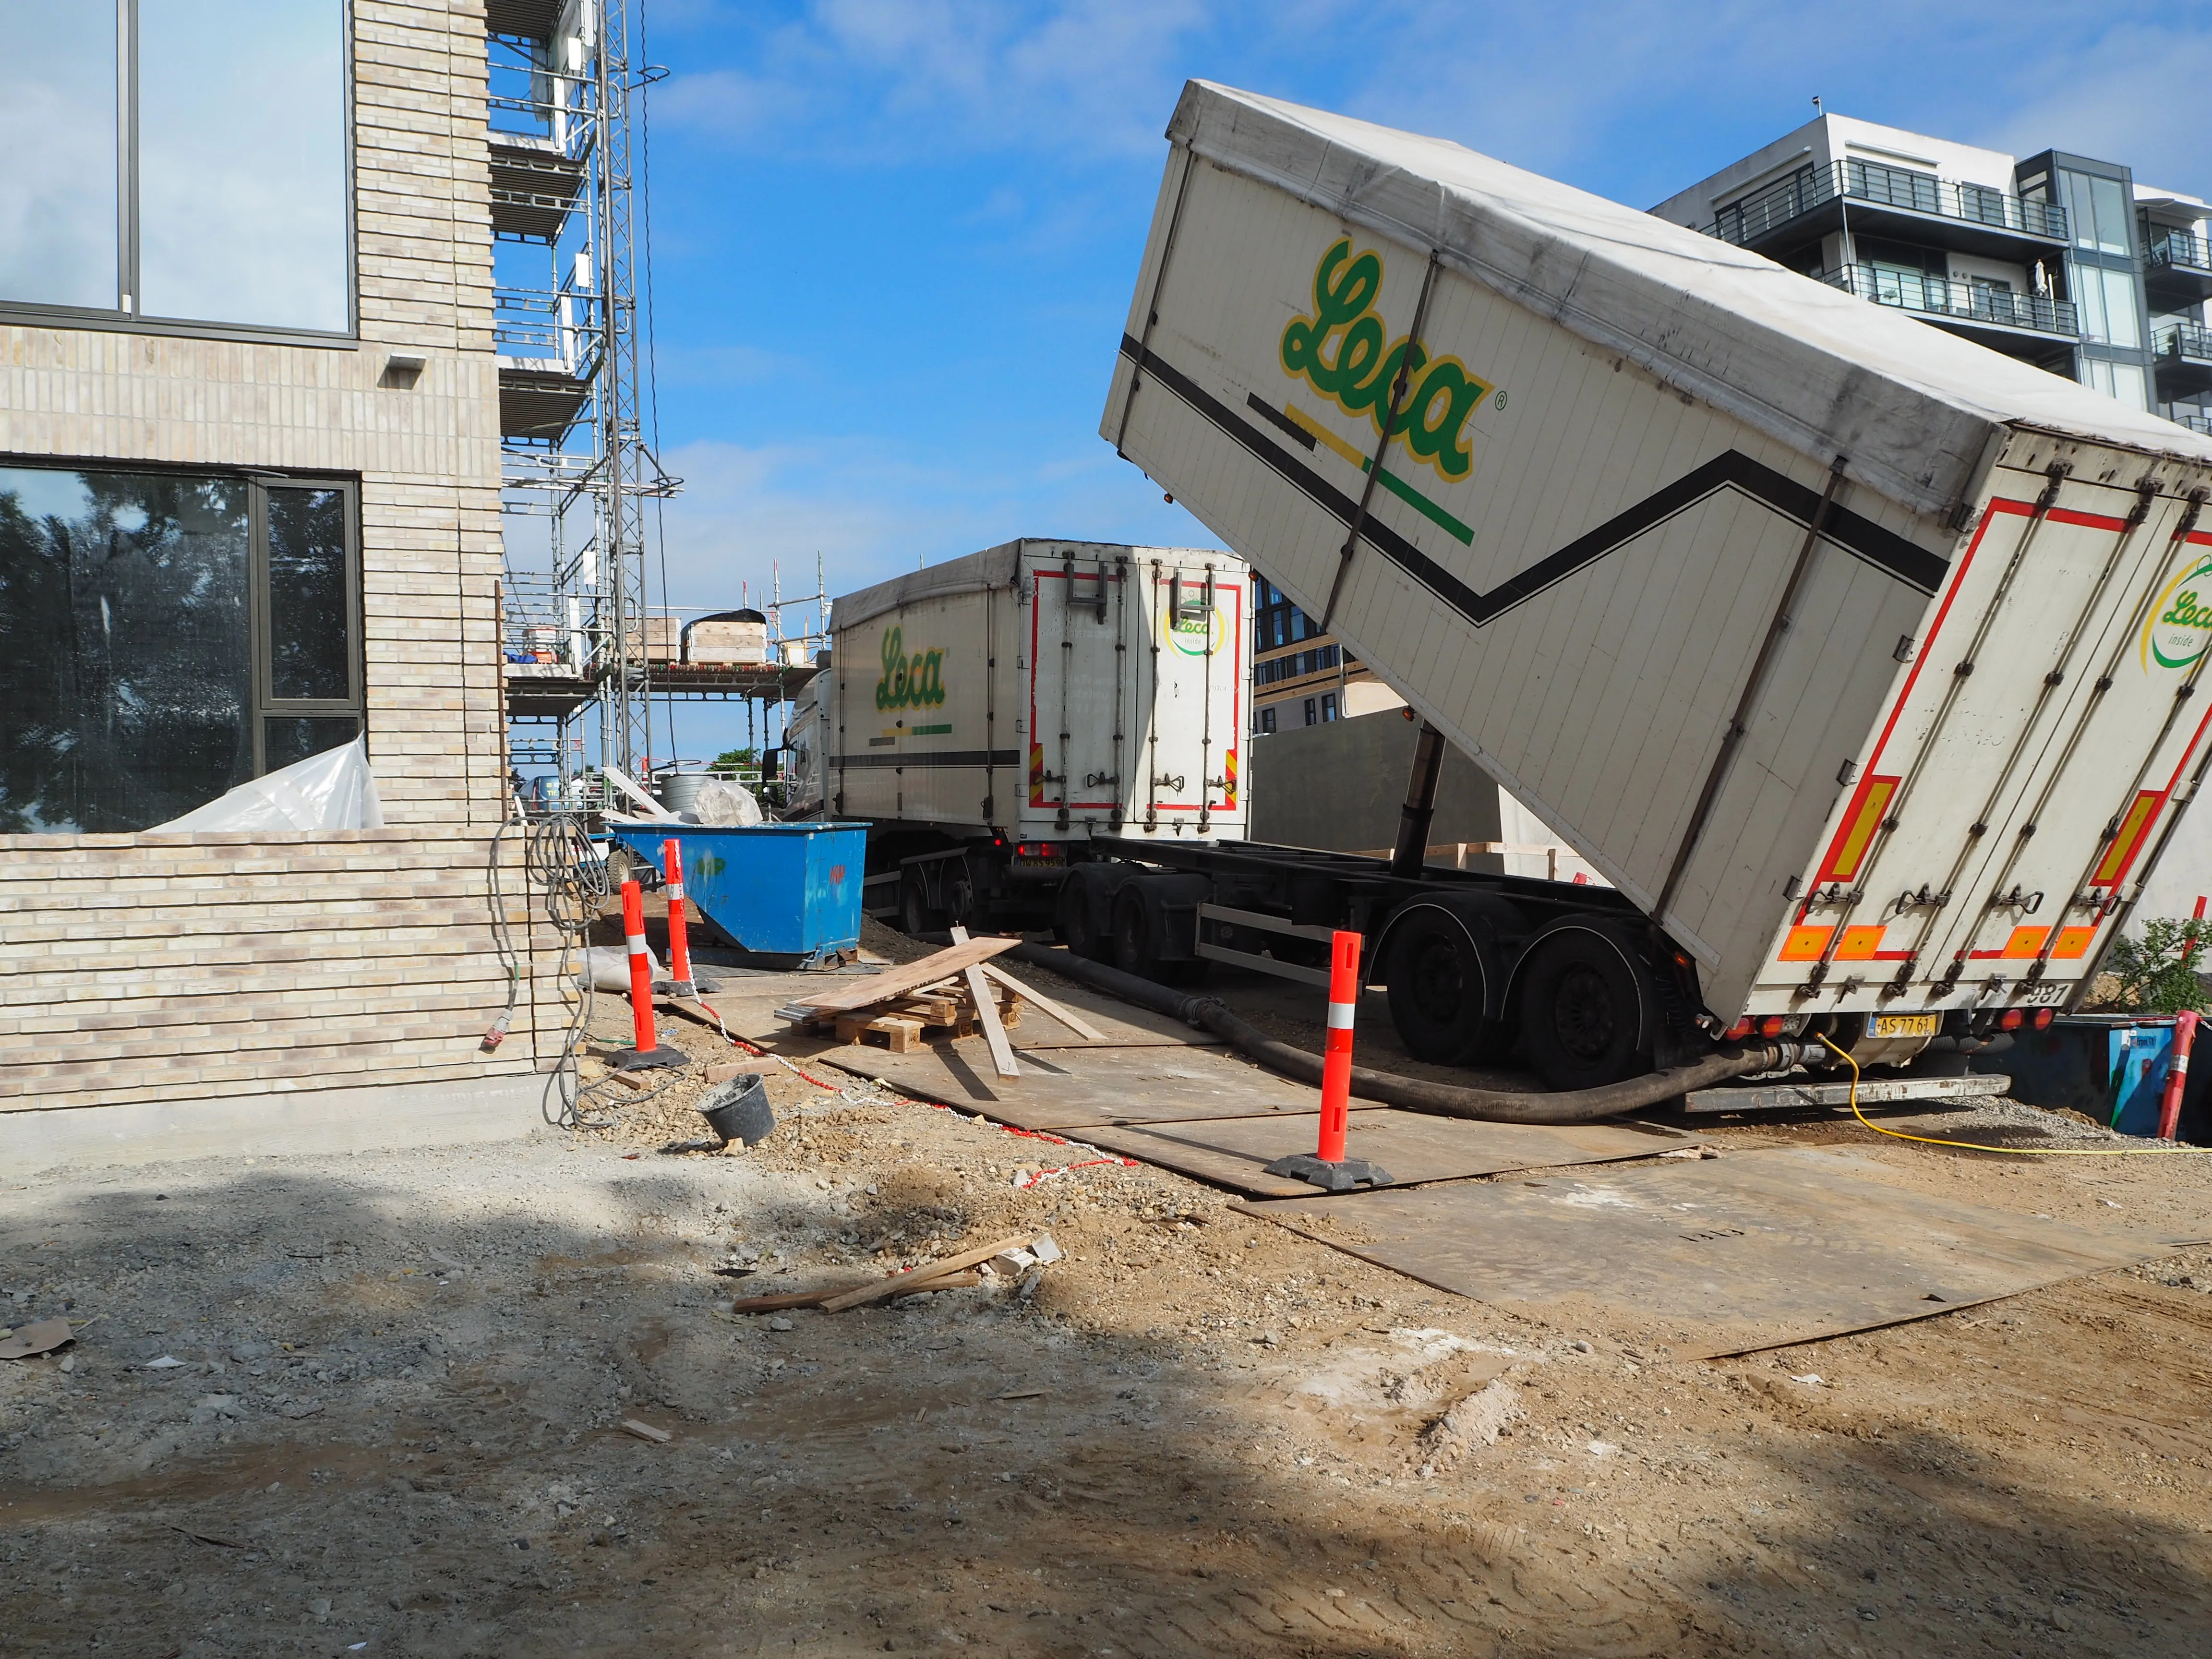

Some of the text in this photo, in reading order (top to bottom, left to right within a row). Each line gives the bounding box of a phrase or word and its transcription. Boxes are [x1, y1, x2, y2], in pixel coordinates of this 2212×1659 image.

[1280, 238, 1494, 483] Leca
[877, 624, 946, 712] Leca
[2168, 633, 2193, 647] inside
